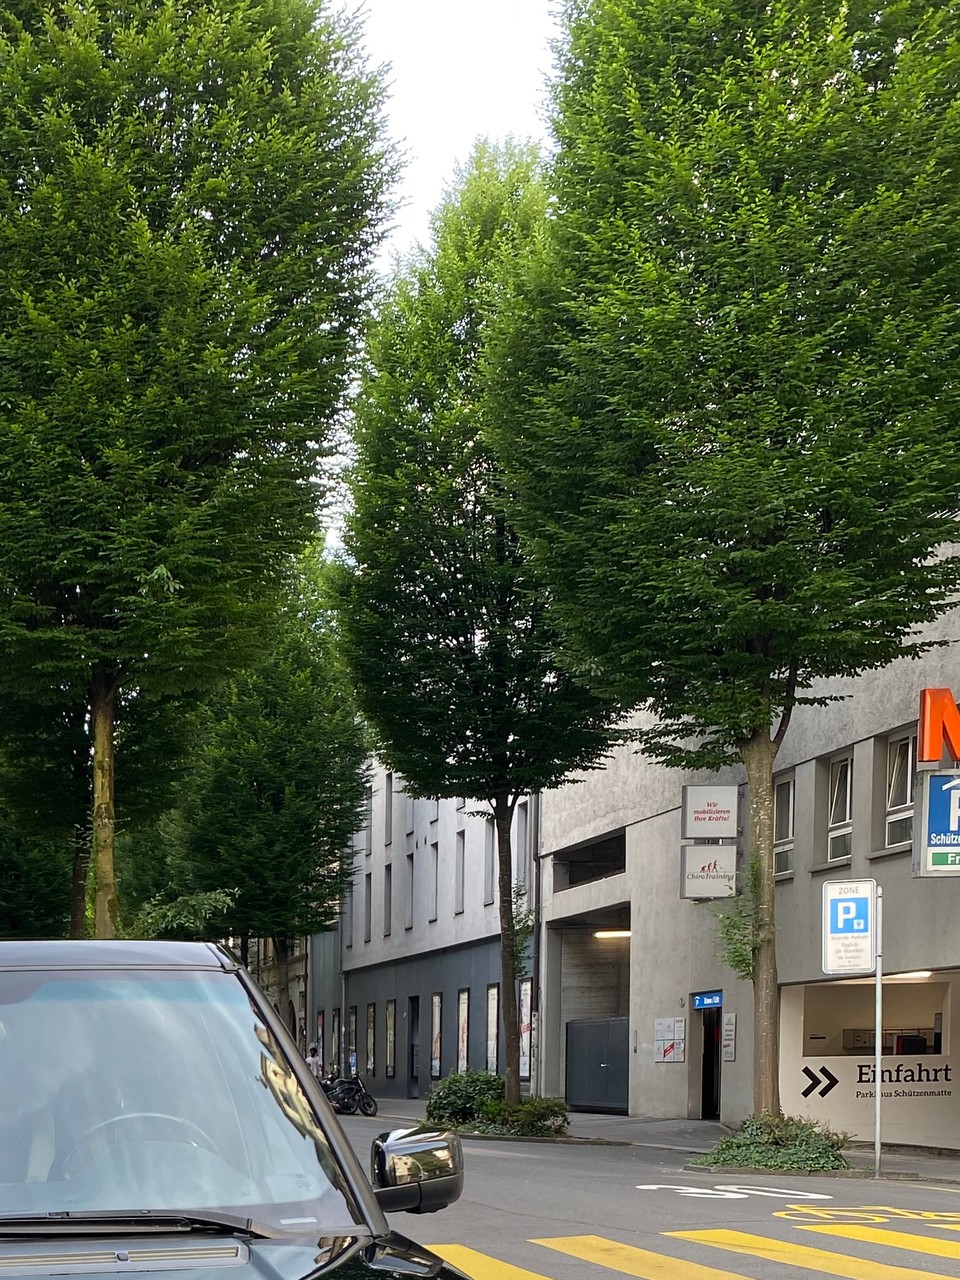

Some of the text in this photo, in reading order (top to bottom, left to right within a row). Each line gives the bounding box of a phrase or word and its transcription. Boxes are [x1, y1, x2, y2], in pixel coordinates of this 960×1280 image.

[930, 832, 960, 845] Schütz
[838, 886, 860, 895] ZONE
[837, 901, 857, 929] P
[856, 1062, 952, 1084] Einfahrt
[893, 1089, 952, 1098] Schützenmatte
